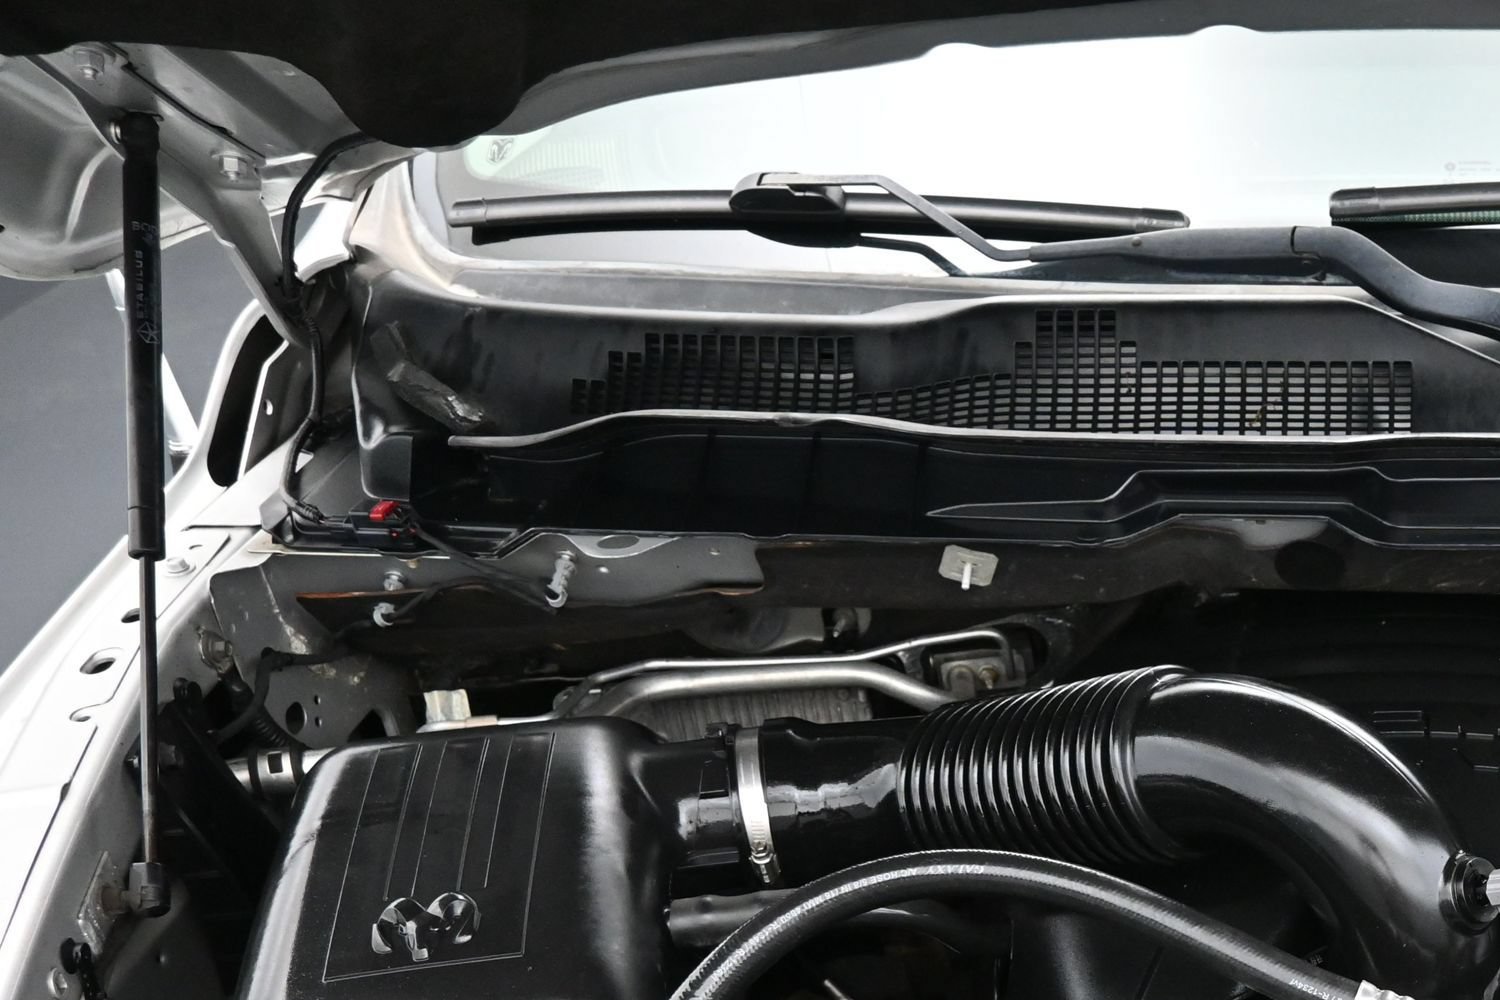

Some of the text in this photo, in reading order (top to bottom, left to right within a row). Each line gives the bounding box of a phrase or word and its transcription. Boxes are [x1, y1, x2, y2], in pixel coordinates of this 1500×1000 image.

[131, 220, 160, 236] BOD
[869, 869, 898, 884] HOSE
[926, 864, 984, 875] GALAXY
